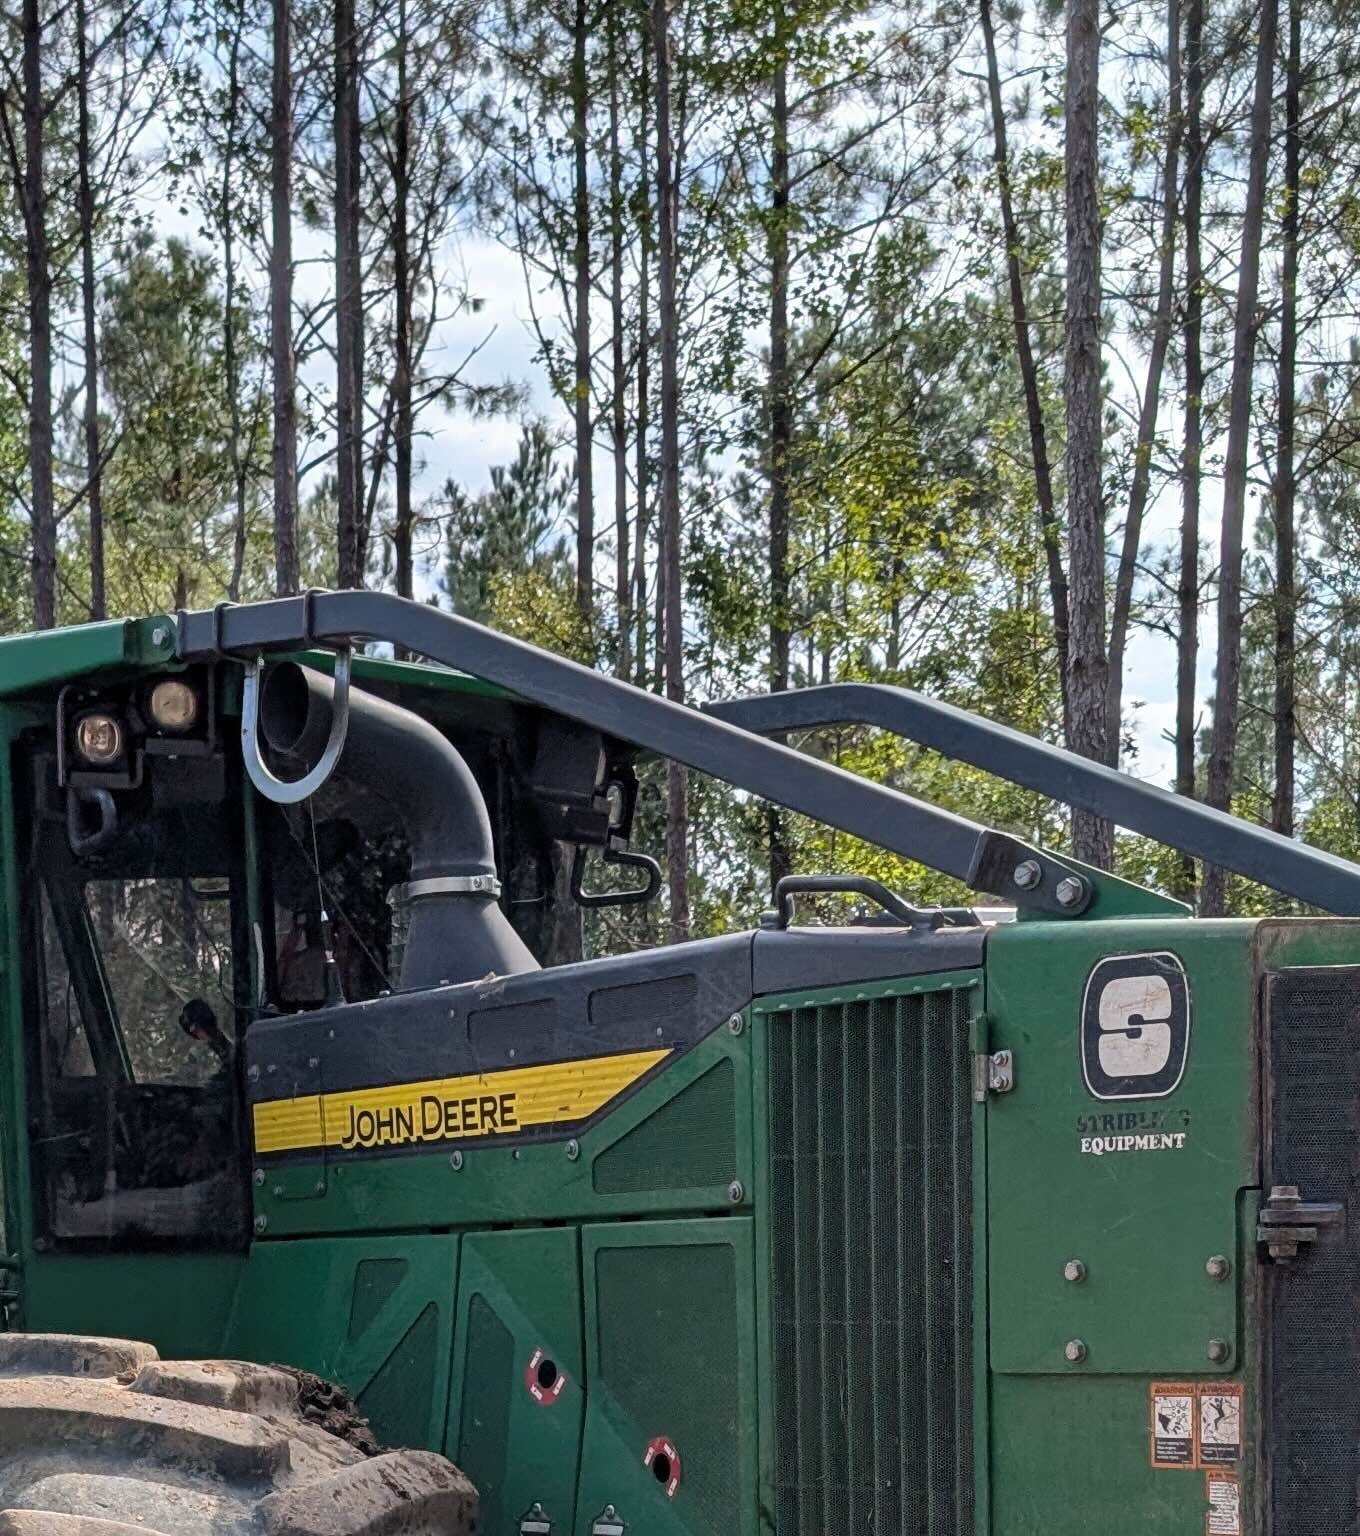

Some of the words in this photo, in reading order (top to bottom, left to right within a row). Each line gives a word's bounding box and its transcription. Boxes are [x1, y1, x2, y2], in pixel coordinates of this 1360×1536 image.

[342, 1104, 414, 1144] JOHN
[421, 1092, 518, 1136] DEERE
[1080, 1132, 1186, 1155] EQUIPMENT
